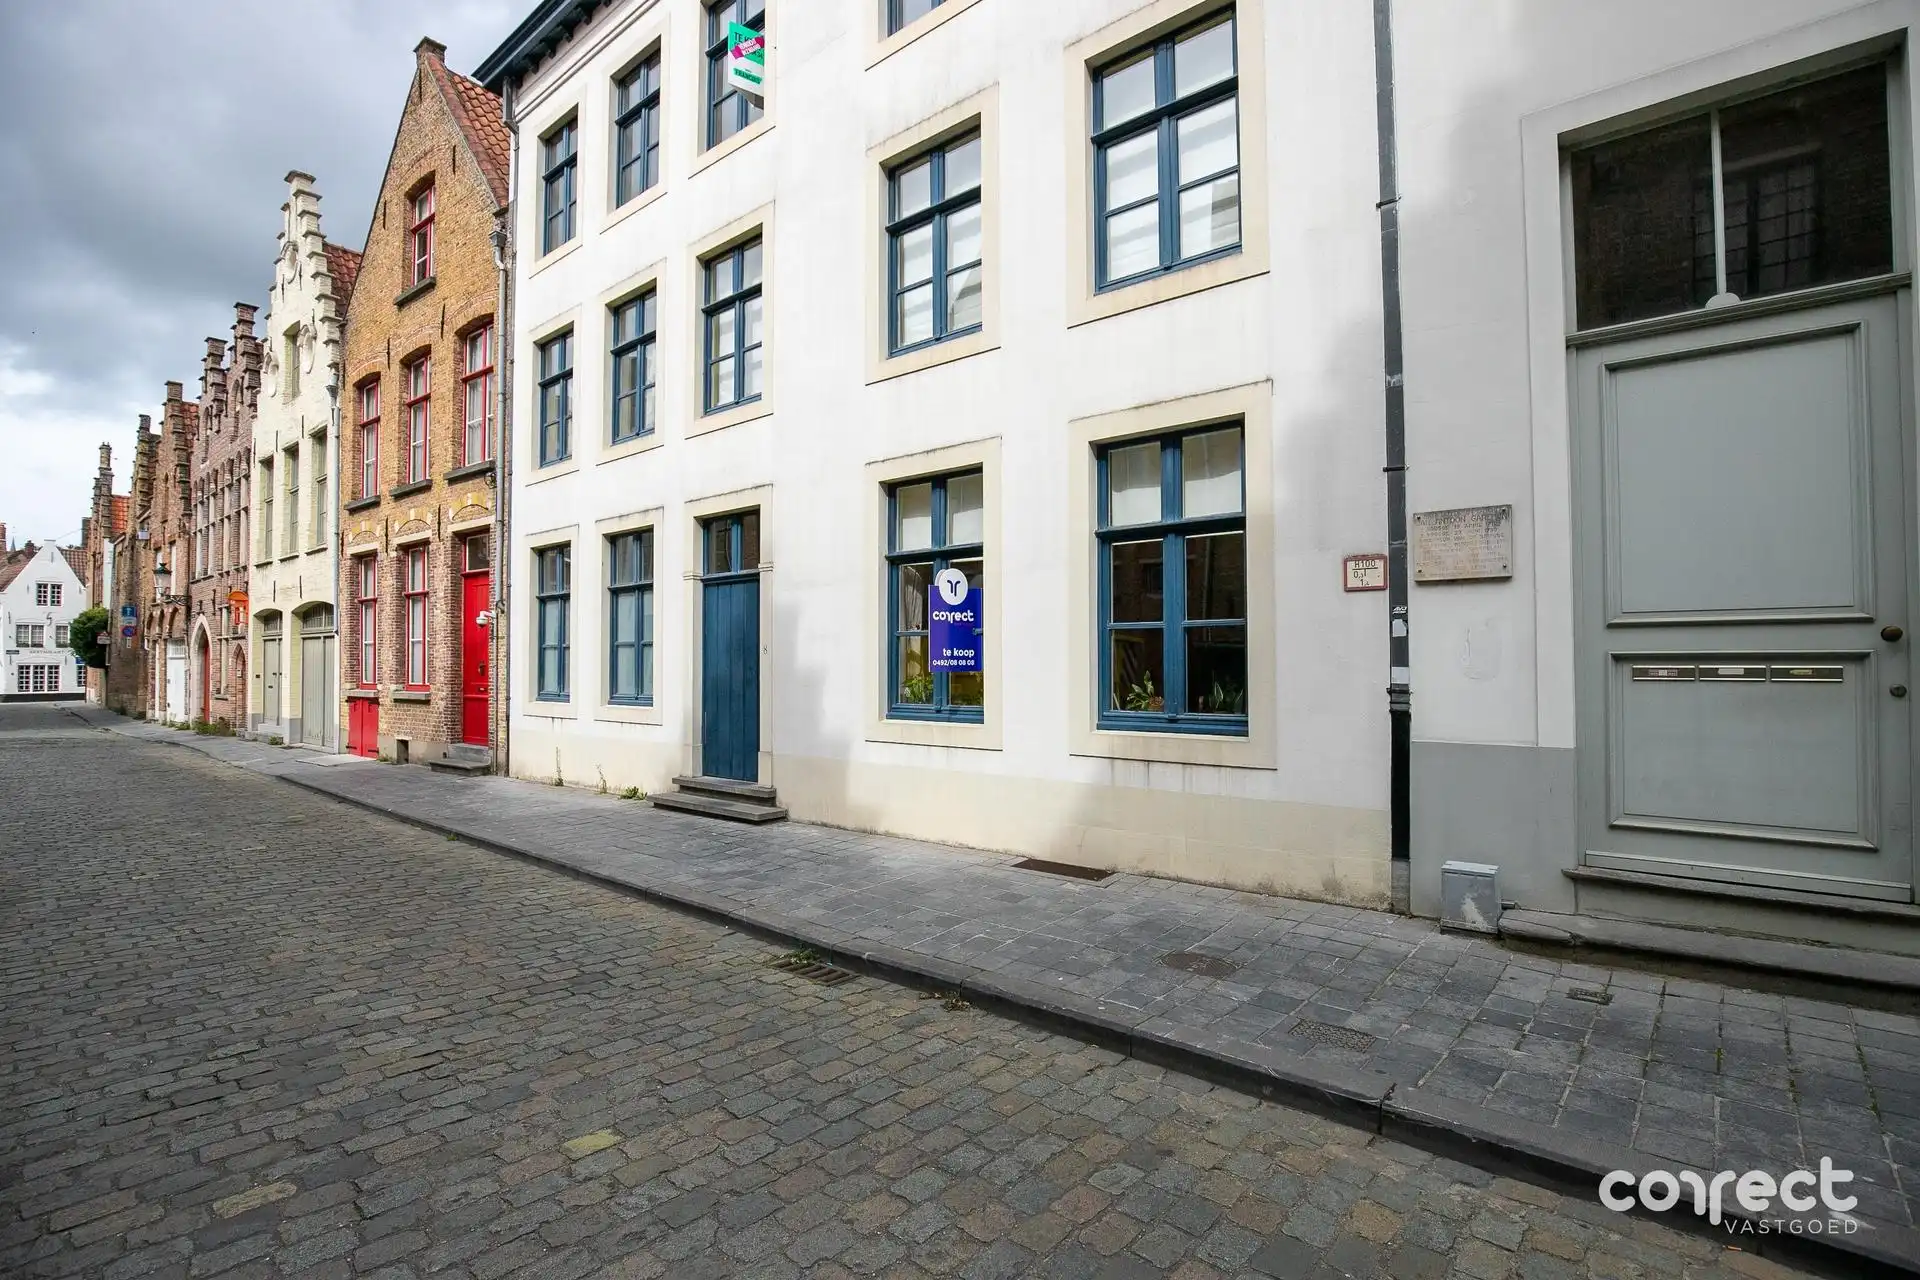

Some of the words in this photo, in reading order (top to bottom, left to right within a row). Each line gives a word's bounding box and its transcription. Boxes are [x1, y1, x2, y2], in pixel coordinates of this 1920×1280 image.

[932, 610, 974, 623] correct
[943, 648, 951, 656] te
[953, 647, 975, 658] koop
